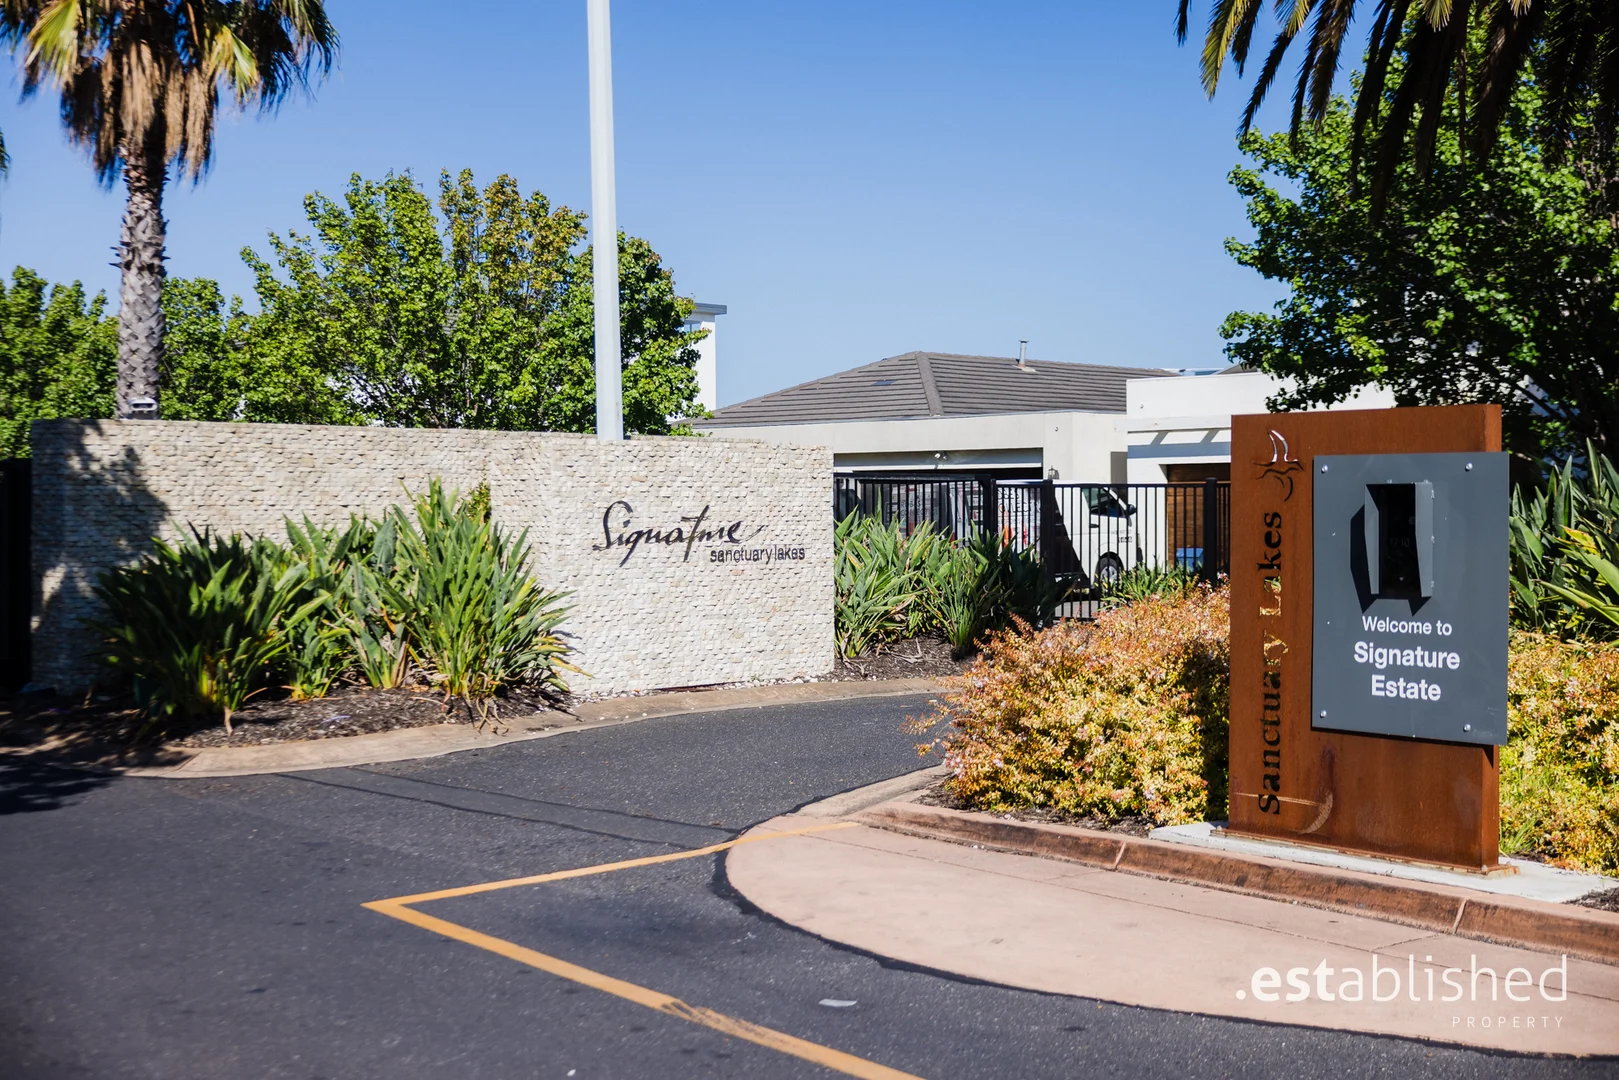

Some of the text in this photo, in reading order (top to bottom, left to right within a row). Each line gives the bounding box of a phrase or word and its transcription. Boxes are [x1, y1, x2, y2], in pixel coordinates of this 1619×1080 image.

[592, 500, 766, 567] Signature
[1362, 615, 1453, 636] Welcome to
[1257, 511, 1289, 815] Sanctuary Lakes
[1353, 641, 1461, 670] Signature
[1371, 674, 1442, 702] Estate
